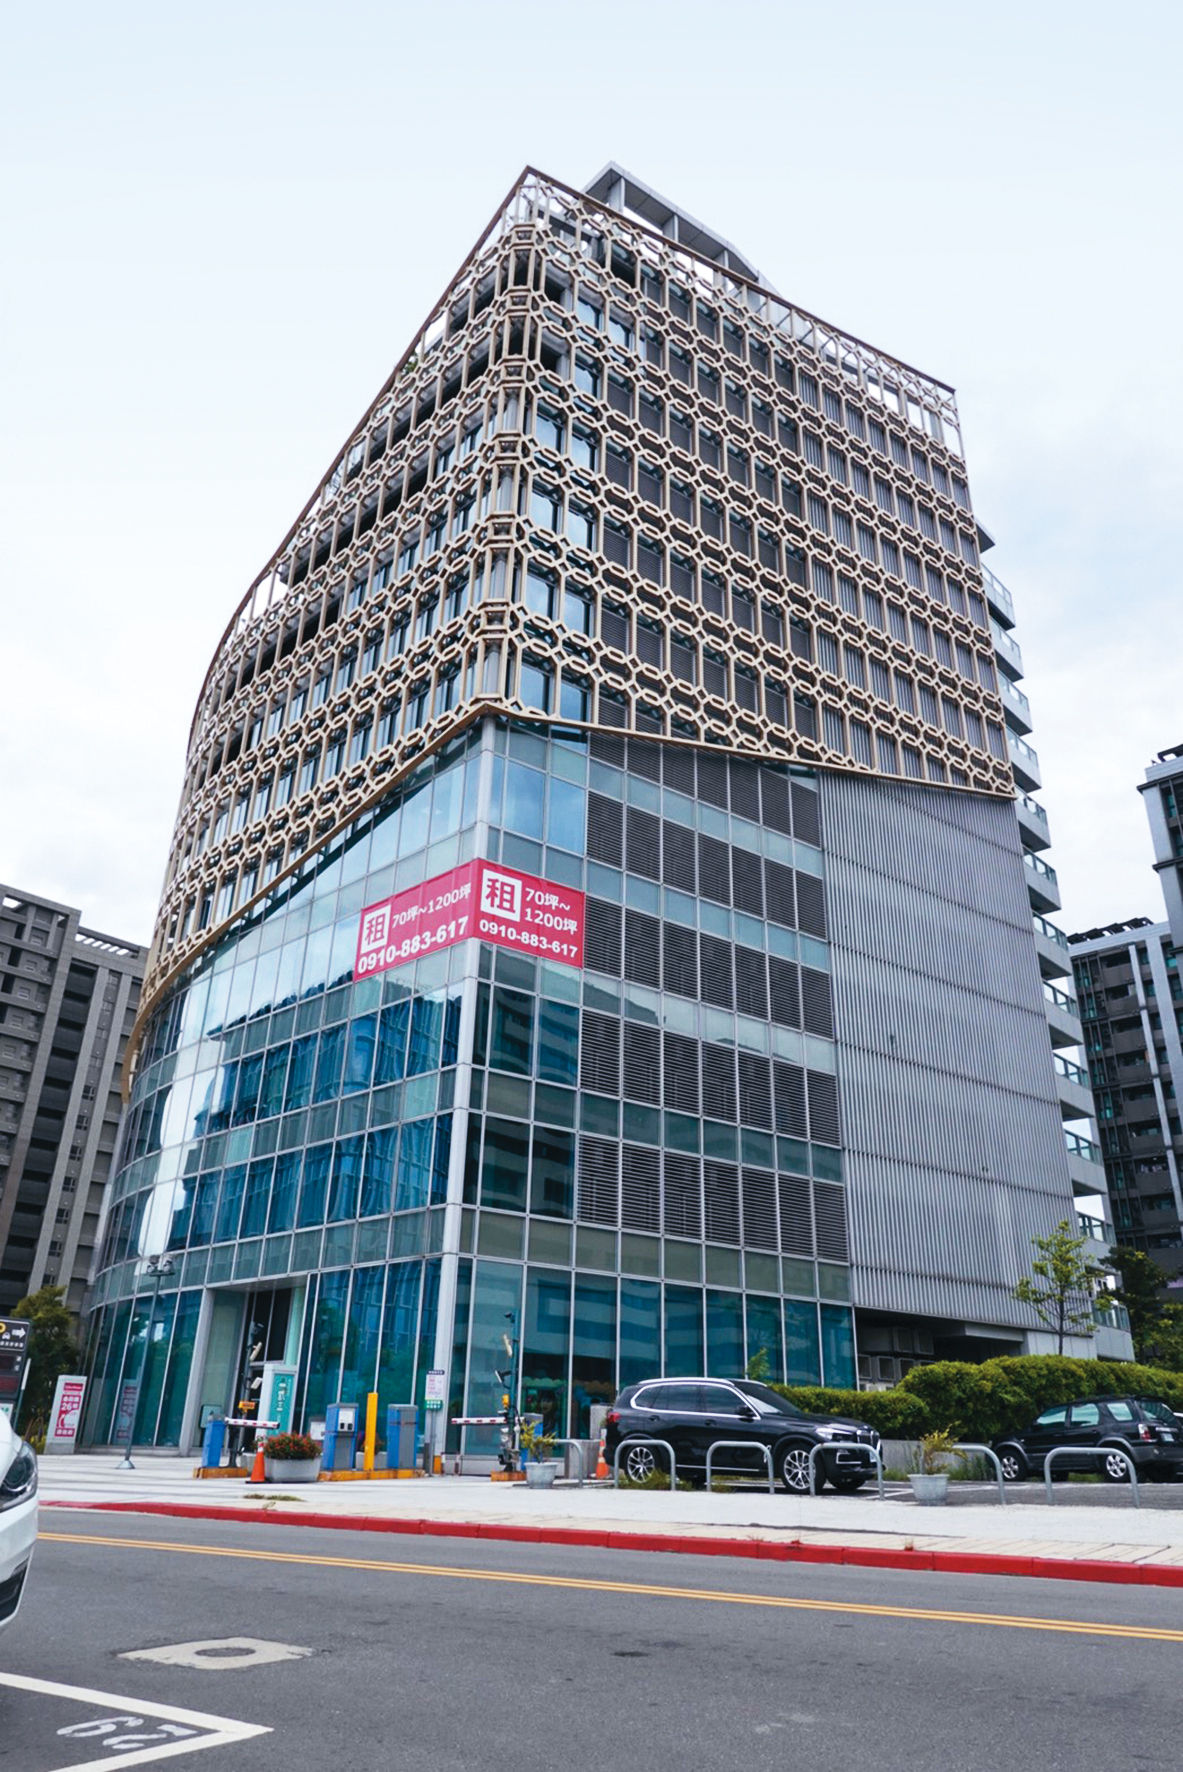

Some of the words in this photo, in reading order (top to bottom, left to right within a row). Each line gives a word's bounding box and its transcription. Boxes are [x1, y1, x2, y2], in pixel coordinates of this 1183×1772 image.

[485, 877, 516, 914] 租
[364, 912, 386, 945] 租
[479, 919, 578, 958] 0910-883-617
[524, 908, 578, 935] 1200坪
[357, 915, 469, 974] 0910-883-617
